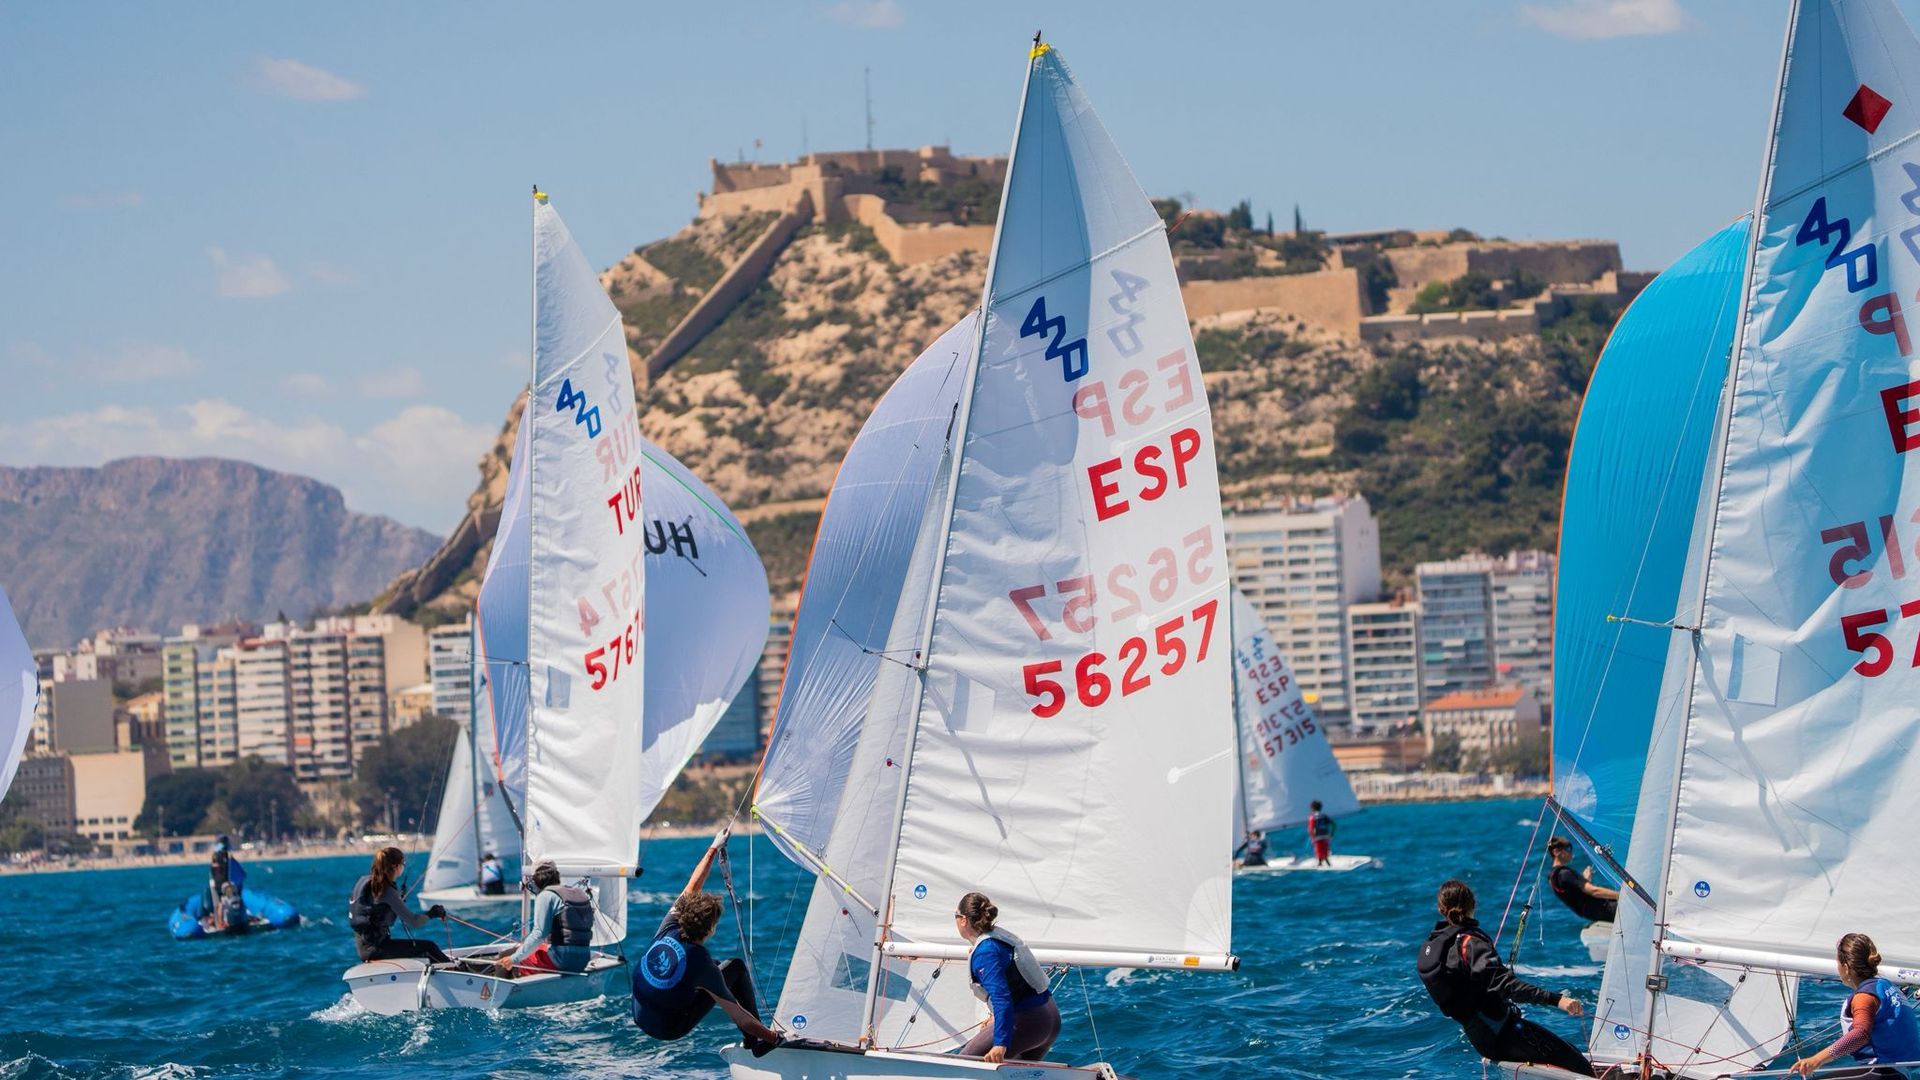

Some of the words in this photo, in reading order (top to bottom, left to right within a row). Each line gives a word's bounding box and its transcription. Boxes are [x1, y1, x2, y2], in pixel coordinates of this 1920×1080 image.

[1795, 196, 1878, 293] 420
[1020, 296, 1089, 382] 420
[556, 377, 602, 439] 420
[608, 466, 642, 536] TUR
[1087, 427, 1201, 522] ESP
[584, 594, 644, 690] 5767
[1022, 599, 1219, 719] 56257
[1256, 675, 1289, 705] ESP
[1264, 718, 1316, 758] 57315
